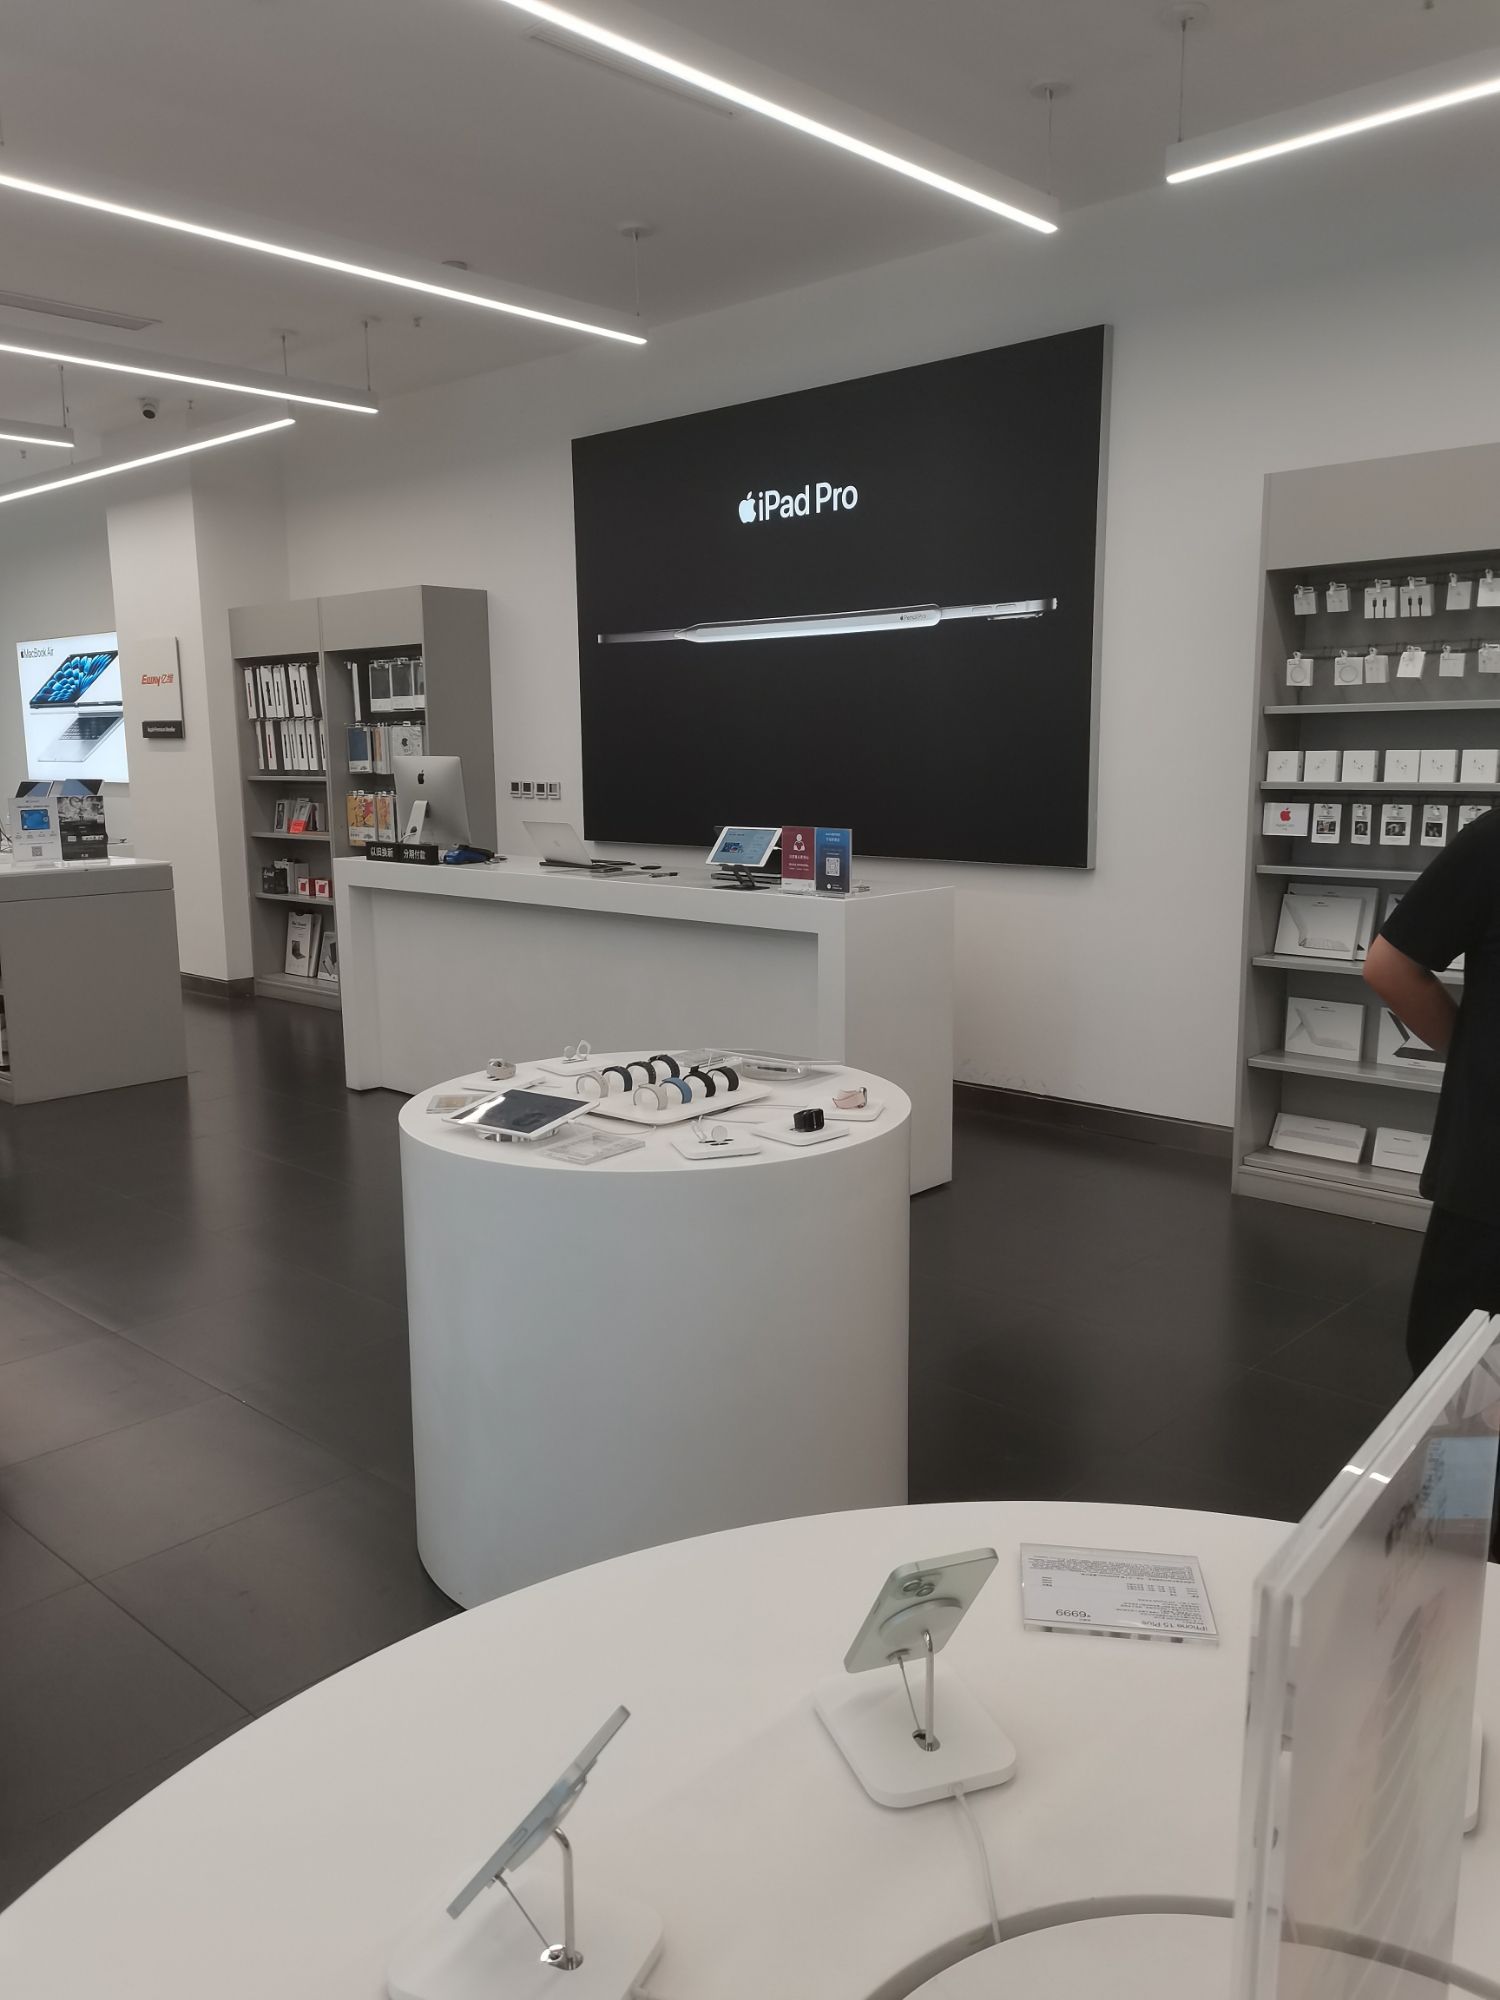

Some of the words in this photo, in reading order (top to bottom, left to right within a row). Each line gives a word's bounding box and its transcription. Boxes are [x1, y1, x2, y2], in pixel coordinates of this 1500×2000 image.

[758, 484, 809, 521] iPad
[815, 482, 858, 514] Pro
[23, 648, 47, 658] MacBook
